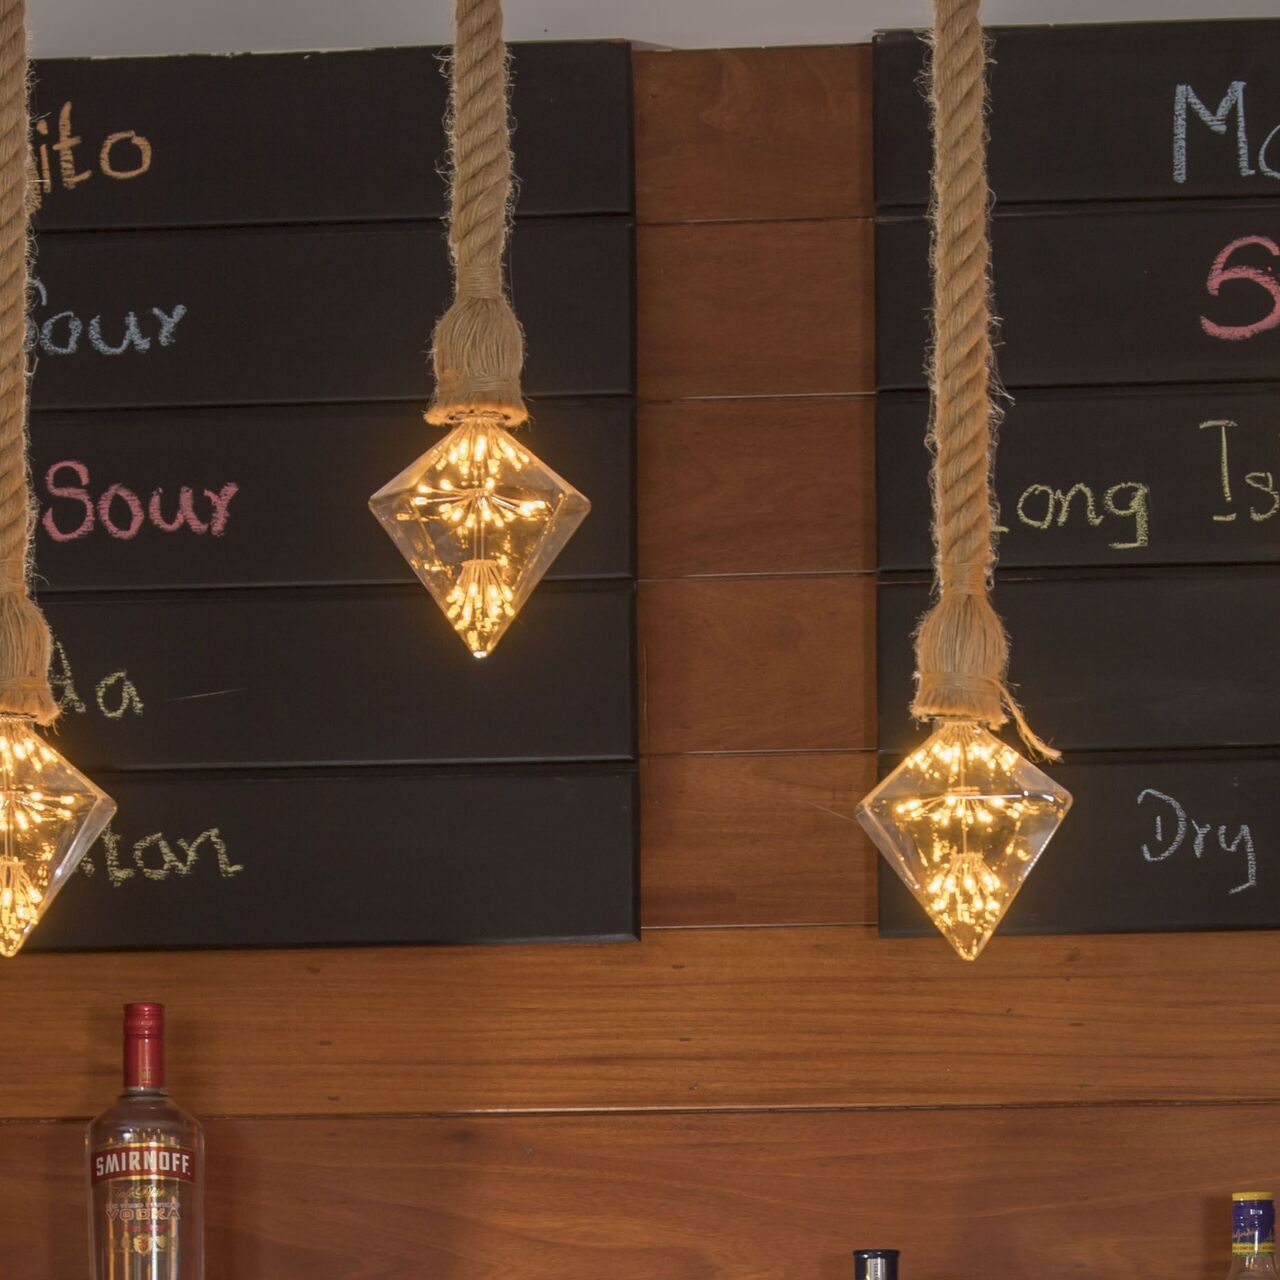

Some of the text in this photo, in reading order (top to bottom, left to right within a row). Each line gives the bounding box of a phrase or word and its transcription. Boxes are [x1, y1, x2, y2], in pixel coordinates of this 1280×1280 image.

[42, 459, 239, 543] Sour
[990, 482, 1150, 548] ong
[1136, 789, 1257, 894] Dry
[96, 1151, 190, 1176] SMIRNOFF
